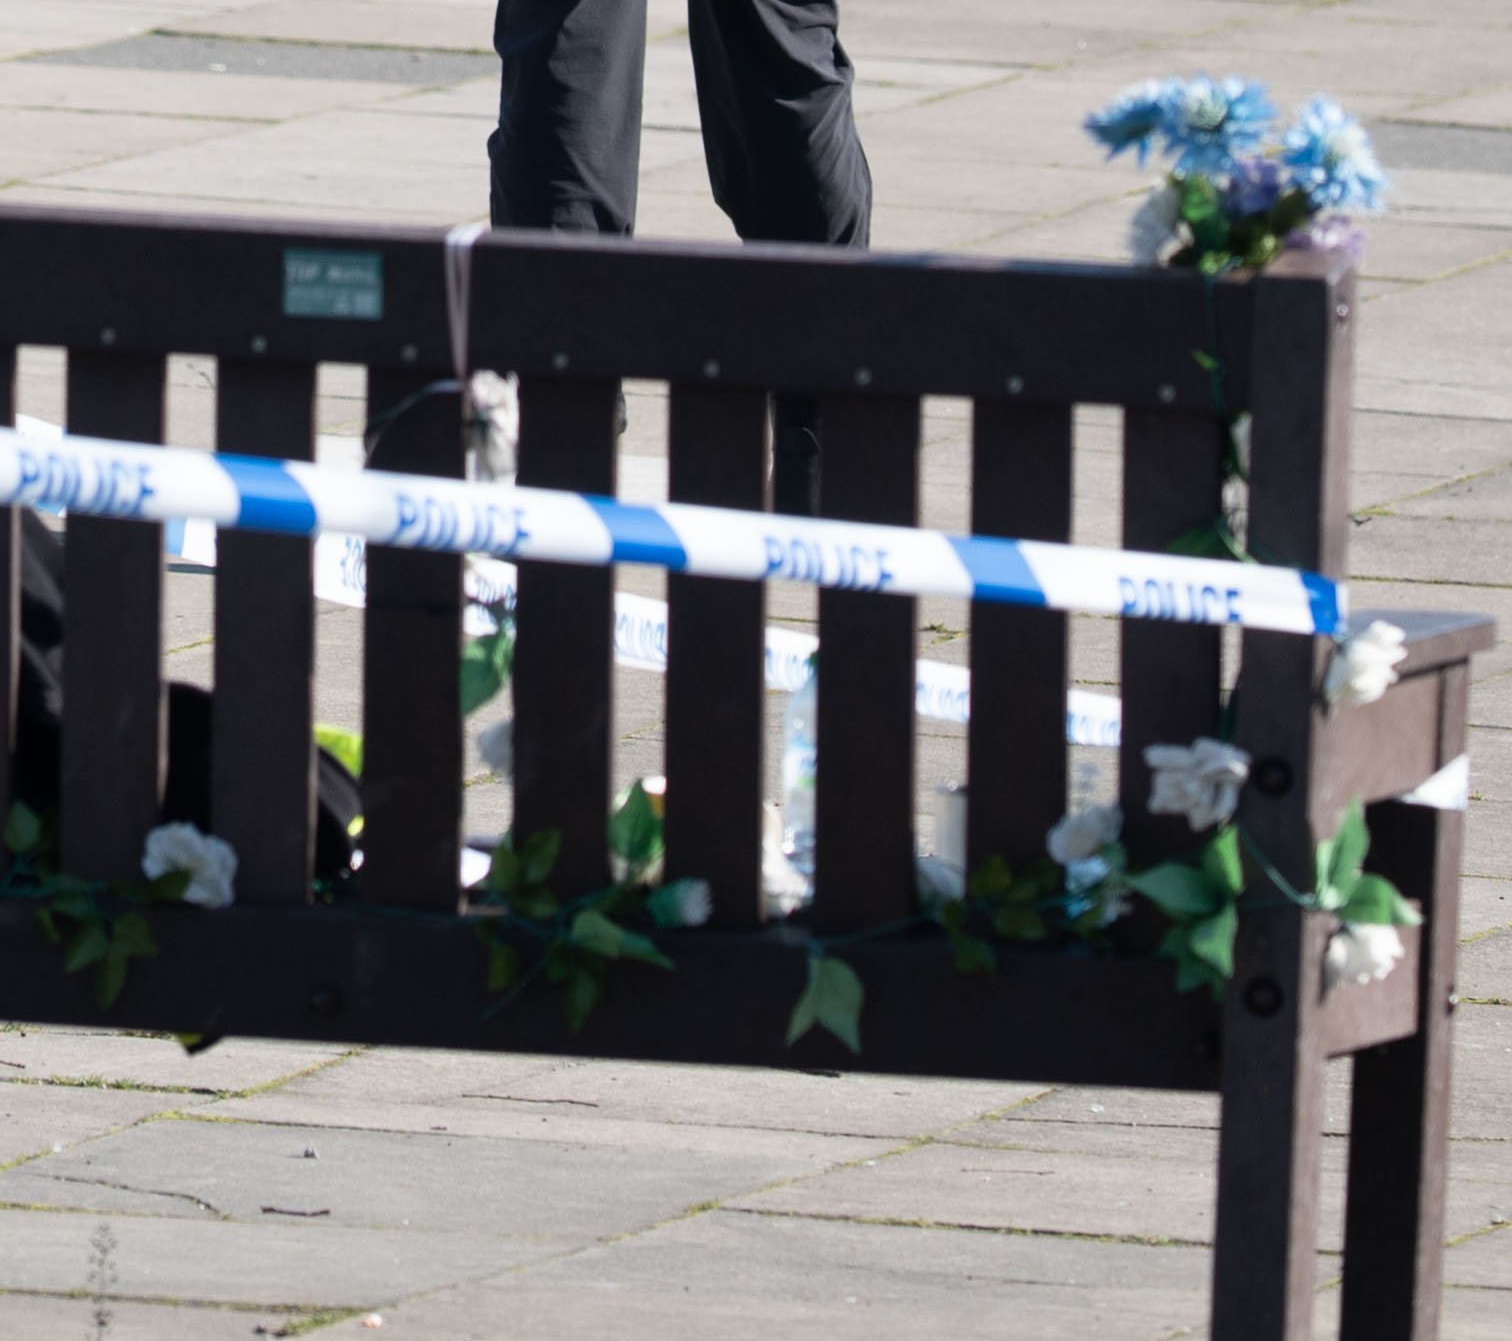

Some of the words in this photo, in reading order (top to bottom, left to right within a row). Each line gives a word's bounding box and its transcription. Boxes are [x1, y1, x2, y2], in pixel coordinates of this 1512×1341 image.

[13, 452, 156, 515] POLICE
[391, 494, 529, 552] POLICE
[765, 539, 891, 590] POLICE
